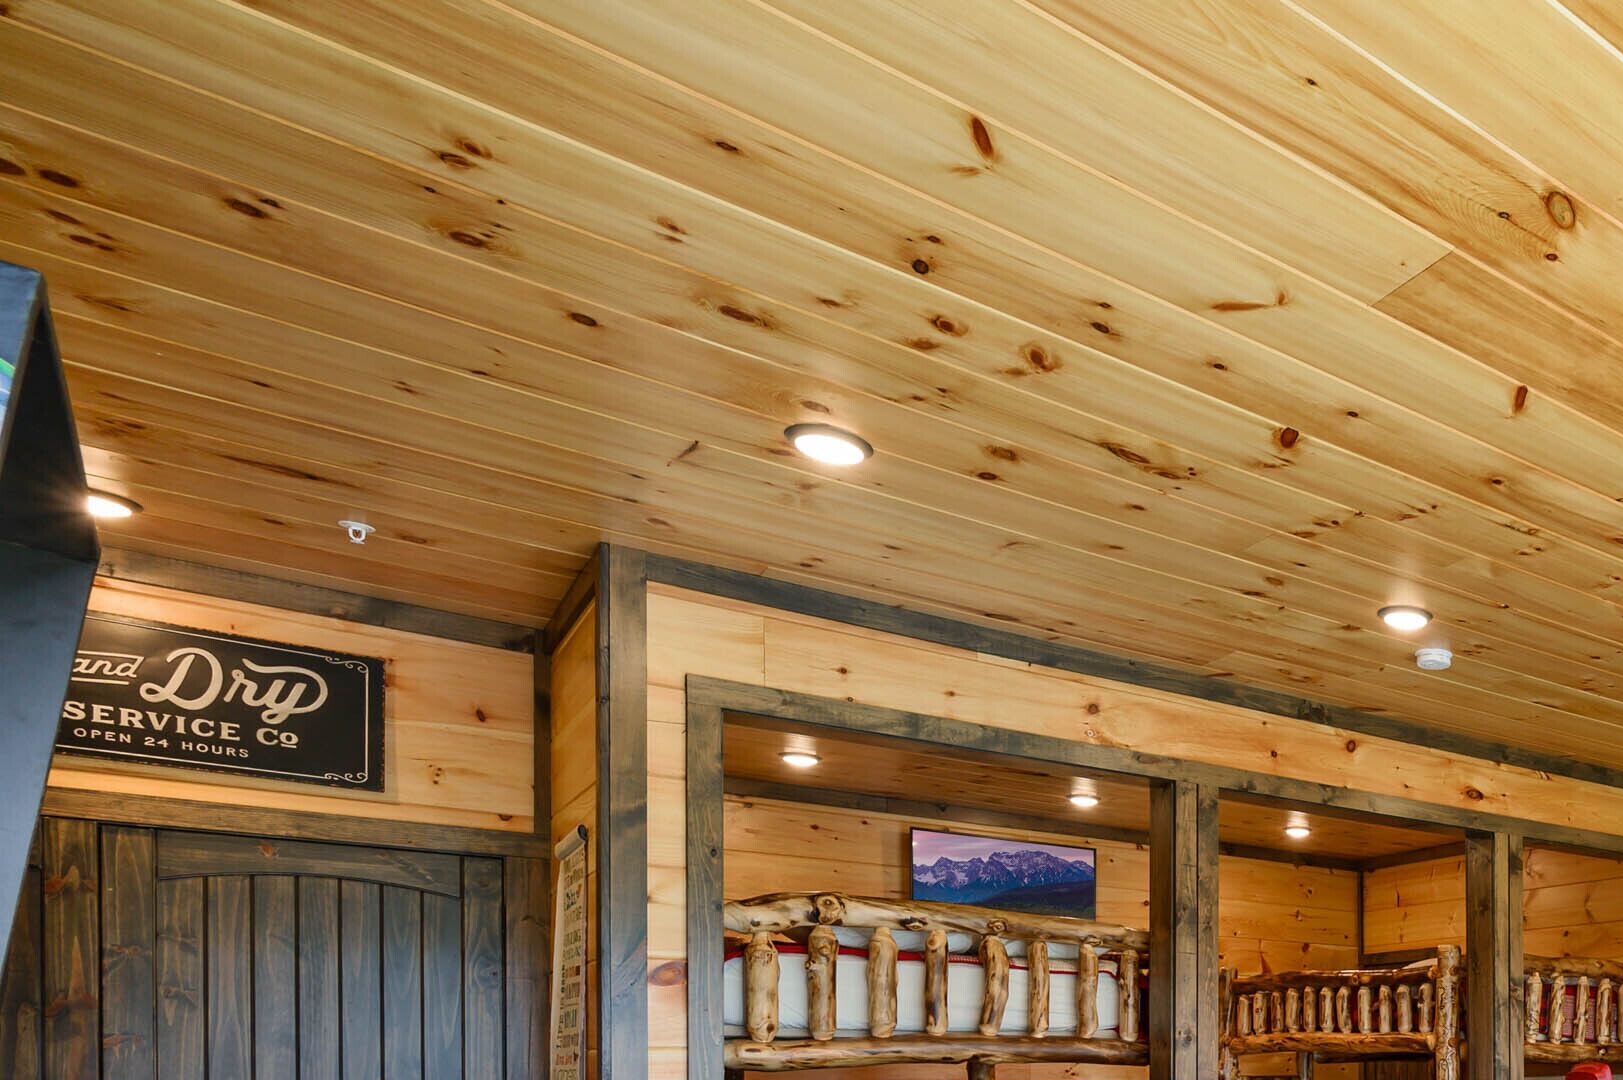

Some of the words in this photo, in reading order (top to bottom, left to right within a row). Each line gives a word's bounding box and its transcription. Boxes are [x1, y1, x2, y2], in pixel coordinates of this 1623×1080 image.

[73, 656, 144, 678] and
[140, 647, 328, 725] Dry
[62, 700, 241, 742] SERVICE
[256, 727, 299, 749] Co
[73, 727, 132, 744] OPEN
[144, 736, 169, 749] 24
[181, 741, 249, 758] HOURS
